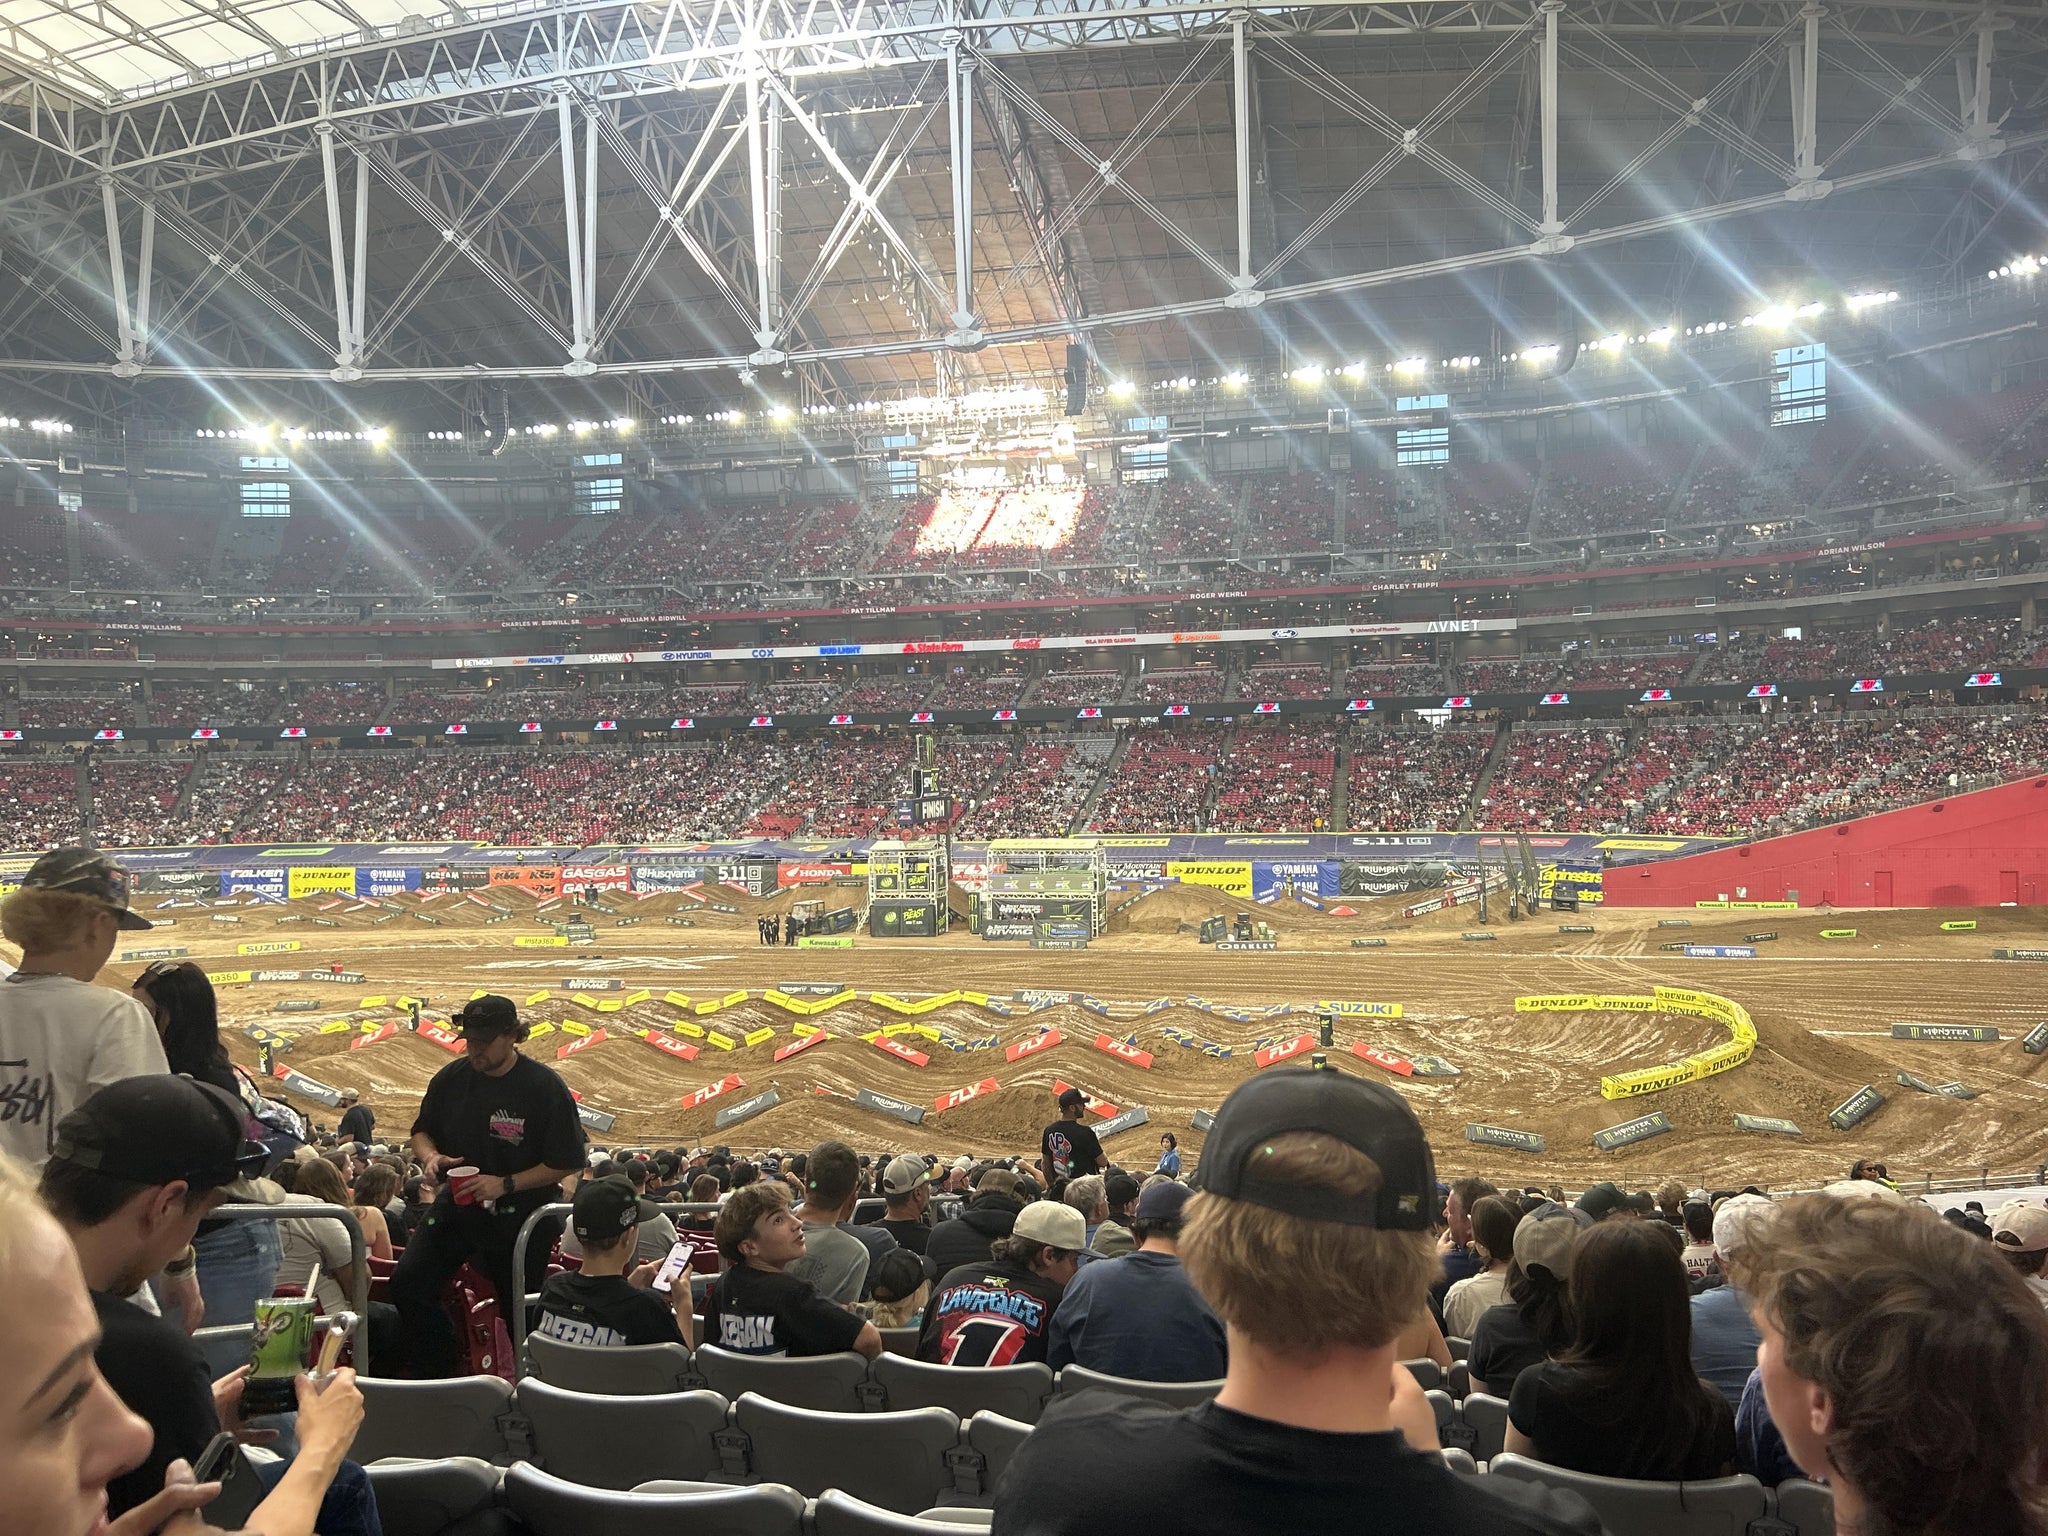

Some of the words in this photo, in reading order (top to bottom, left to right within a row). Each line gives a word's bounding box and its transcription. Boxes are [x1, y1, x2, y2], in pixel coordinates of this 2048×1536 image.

[1818, 547, 1850, 556] ADRIAN
[1852, 542, 1886, 551] WILSON
[1190, 592, 1216, 600] ROGER
[1426, 620, 1480, 633] AVNET
[676, 651, 712, 659] HYUNDAI
[752, 649, 774, 658] COX
[820, 647, 836, 655] BUD
[838, 646, 861, 654] LIGHT
[588, 654, 623, 663] SAFEWAY
[922, 800, 945, 819] FINISH
[1352, 837, 1404, 845] 5.11
[230, 869, 284, 878] FALKEN
[377, 870, 406, 878] YAMAHA
[494, 870, 520, 880] KTM
[530, 870, 555, 879] KTM
[562, 866, 627, 878] GASGAS
[647, 869, 696, 879] Husqvarna
[718, 866, 746, 880] 5.11
[1282, 865, 1318, 874] YAMAHA
[1359, 866, 1399, 874] TRIUMPH
[426, 872, 459, 880] SCREAM
[377, 884, 406, 893] YAMAHA
[1359, 883, 1399, 891] TRIUMPH
[903, 908, 926, 921] BEAST
[246, 942, 294, 952] SUZUKI
[1530, 999, 1588, 1007] DUNLOP
[1664, 992, 1697, 1002] DUNLOP
[1330, 1003, 1392, 1014] SUZUKI
[1666, 1005, 1703, 1016] DUNLOP
[426, 1028, 458, 1044] FLY
[1923, 1028, 1970, 1036] MONSTER
[568, 1034, 594, 1053] FLY
[656, 1037, 688, 1051] FLY
[786, 1035, 814, 1053] FLY
[886, 1041, 919, 1056] FLY
[1018, 1035, 1047, 1054] FLY
[1108, 1041, 1142, 1057] FLY
[1270, 1039, 1299, 1060] FLY
[1366, 1050, 1400, 1064] FLY
[1713, 1048, 1750, 1071] DUNLOP
[1629, 1071, 1694, 1093] DUNLOP
[695, 1080, 726, 1104] FLY
[949, 1083, 980, 1106] FLY
[728, 1099, 757, 1116] TRIUMPH
[872, 1096, 904, 1110] TRIUMPH
[1844, 1095, 1869, 1114] MONSTER
[1487, 1129, 1526, 1140] MONSTER
[1614, 1120, 1652, 1137] MONSTER
[939, 1287, 1043, 1328] LAWRENCE
[948, 1317, 1019, 1368] 1
